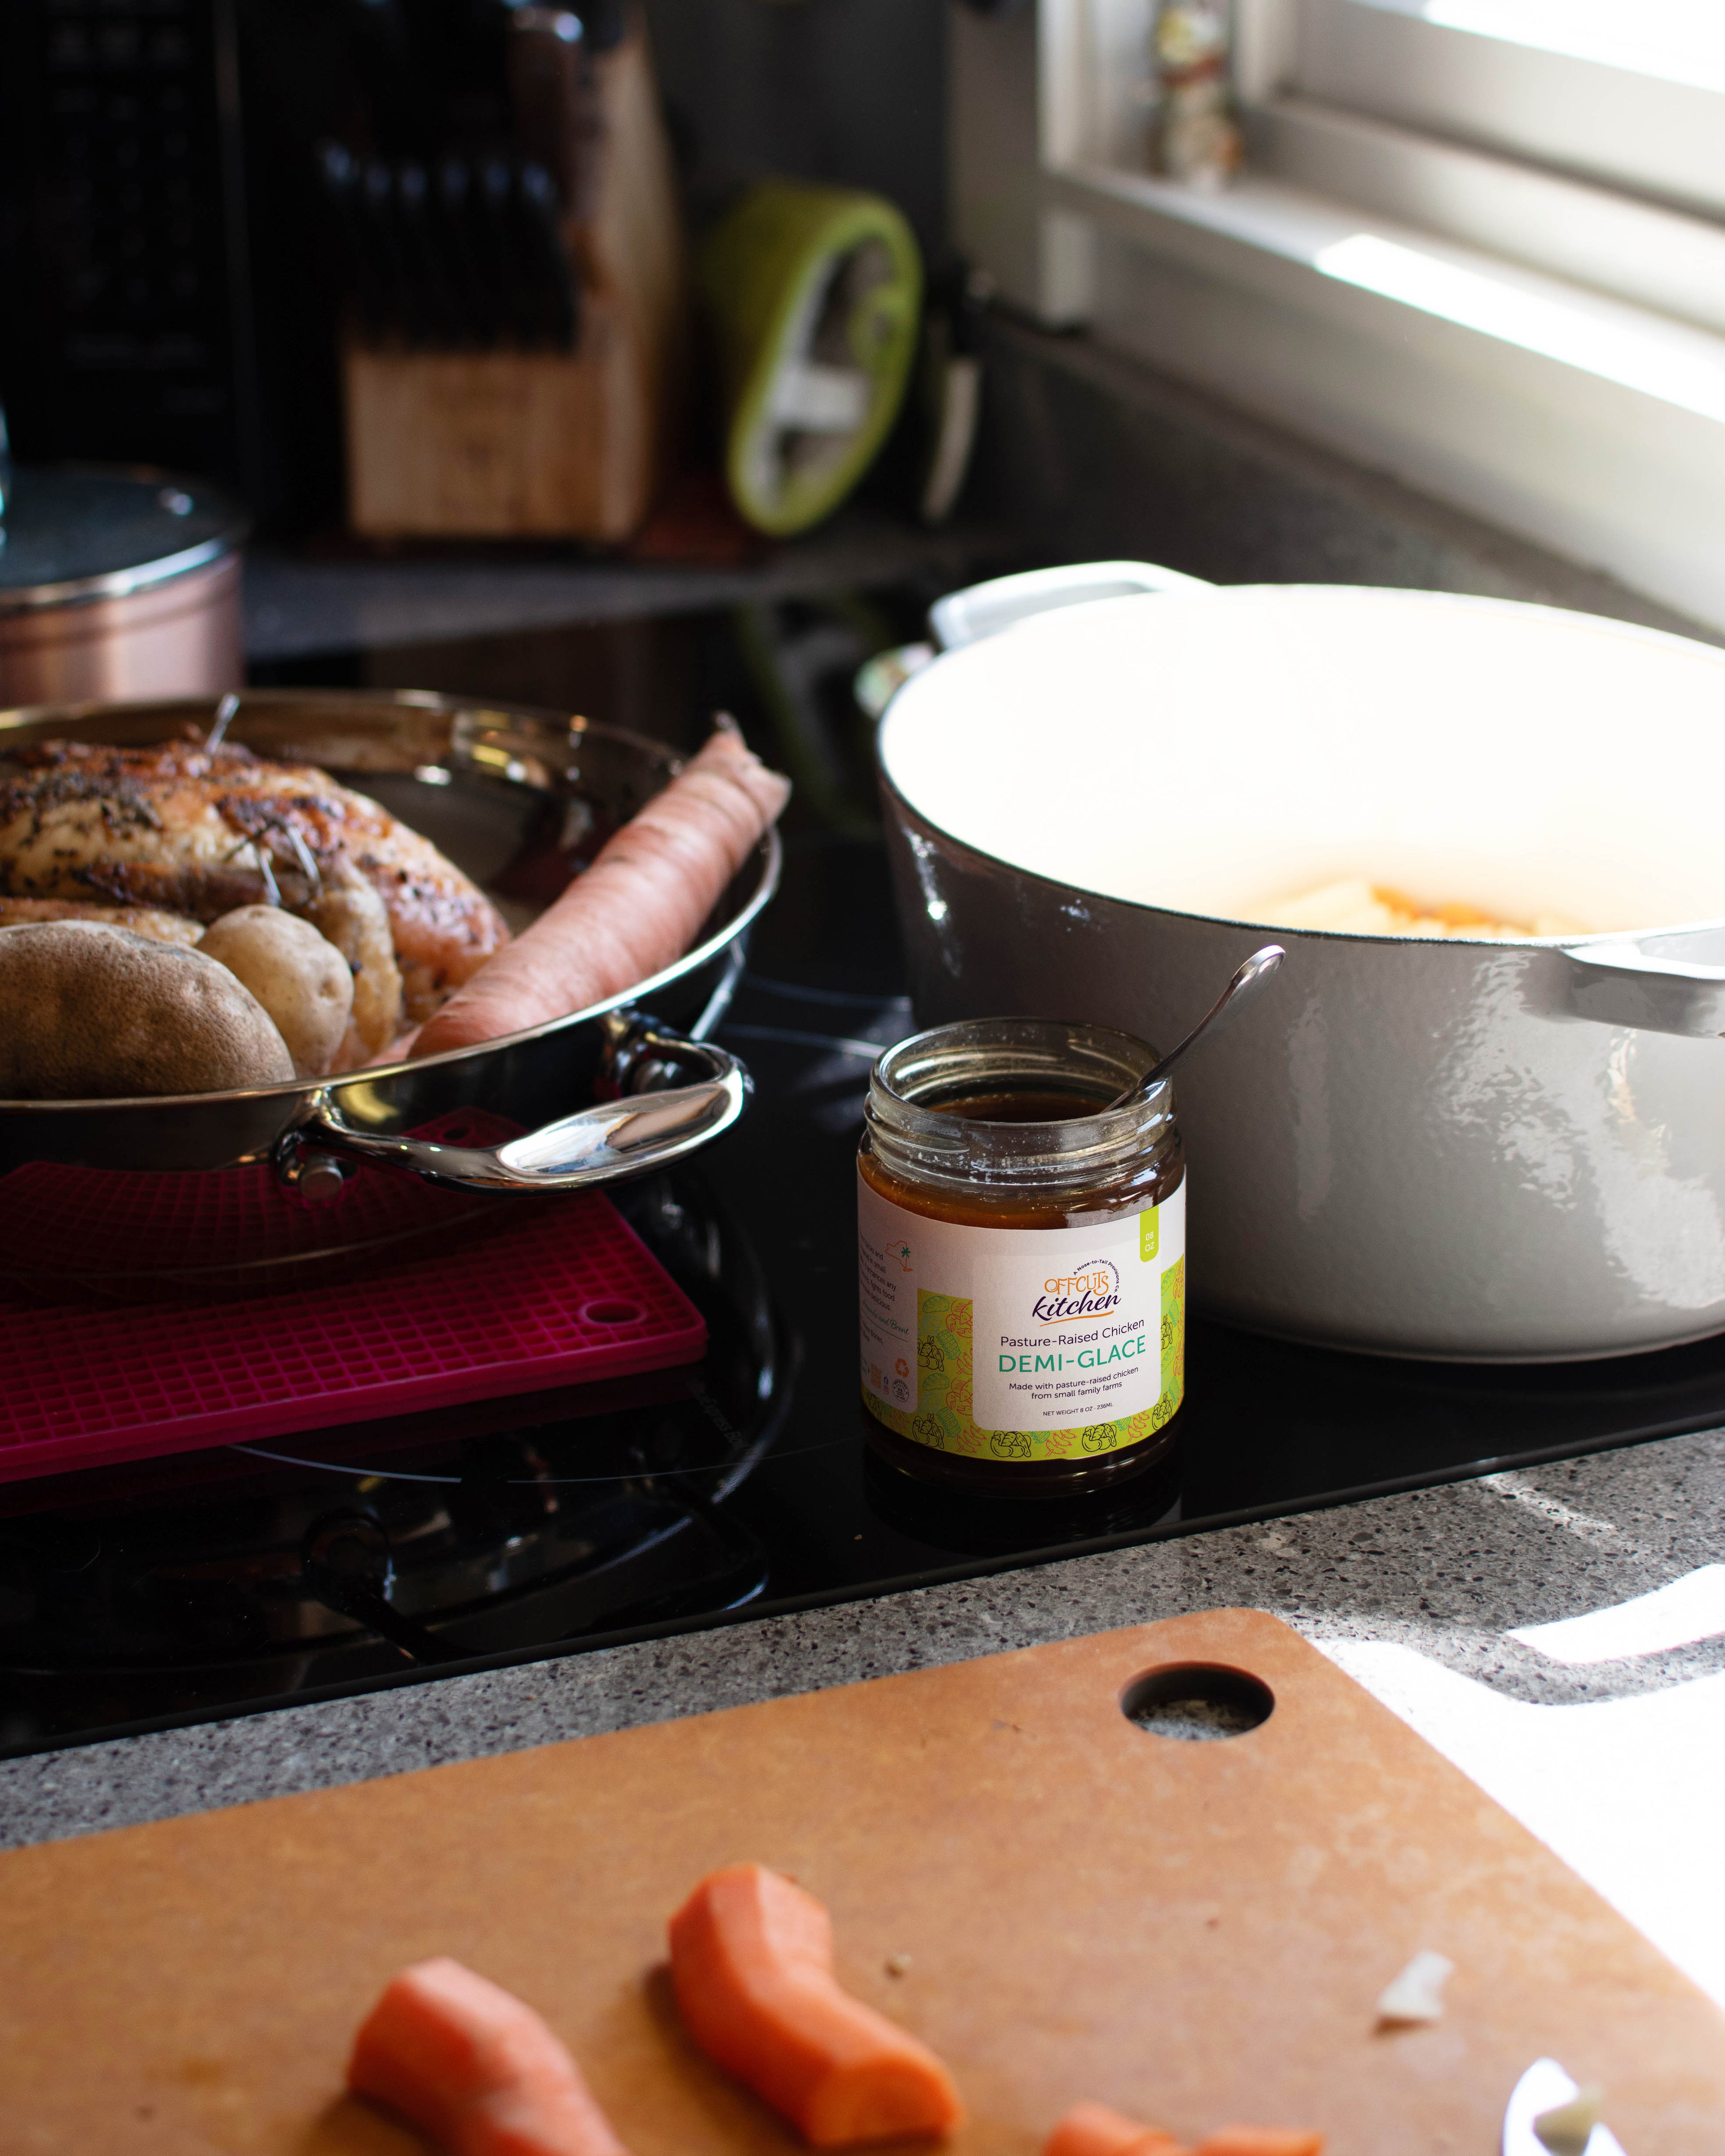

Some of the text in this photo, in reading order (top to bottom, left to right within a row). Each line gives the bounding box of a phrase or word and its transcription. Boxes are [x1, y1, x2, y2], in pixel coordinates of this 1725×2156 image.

[1146, 1231, 1154, 1241] 08
[1145, 1241, 1154, 1252] OZ
[875, 1251, 883, 1260] and
[874, 1261, 886, 1273] small
[1077, 1259, 1108, 1271] Nose-to-Tail
[1108, 1262, 1119, 1284] Provisions
[886, 1281, 896, 1291] any
[1044, 1271, 1109, 1296] OFFCUTS
[883, 1289, 894, 1301] food
[1032, 1290, 1121, 1321] kitchen
[890, 1319, 909, 1335] Brent
[1001, 1319, 1144, 1347] Pasture-Raised Chicken
[999, 1334, 1146, 1372] DEMI-GLACE
[1056, 1374, 1111, 1390] pasture-raised
[1113, 1367, 1138, 1379] chicken
[1054, 1390, 1075, 1398] small
[1078, 1387, 1101, 1396] family
[1103, 1382, 1122, 1391] farms
